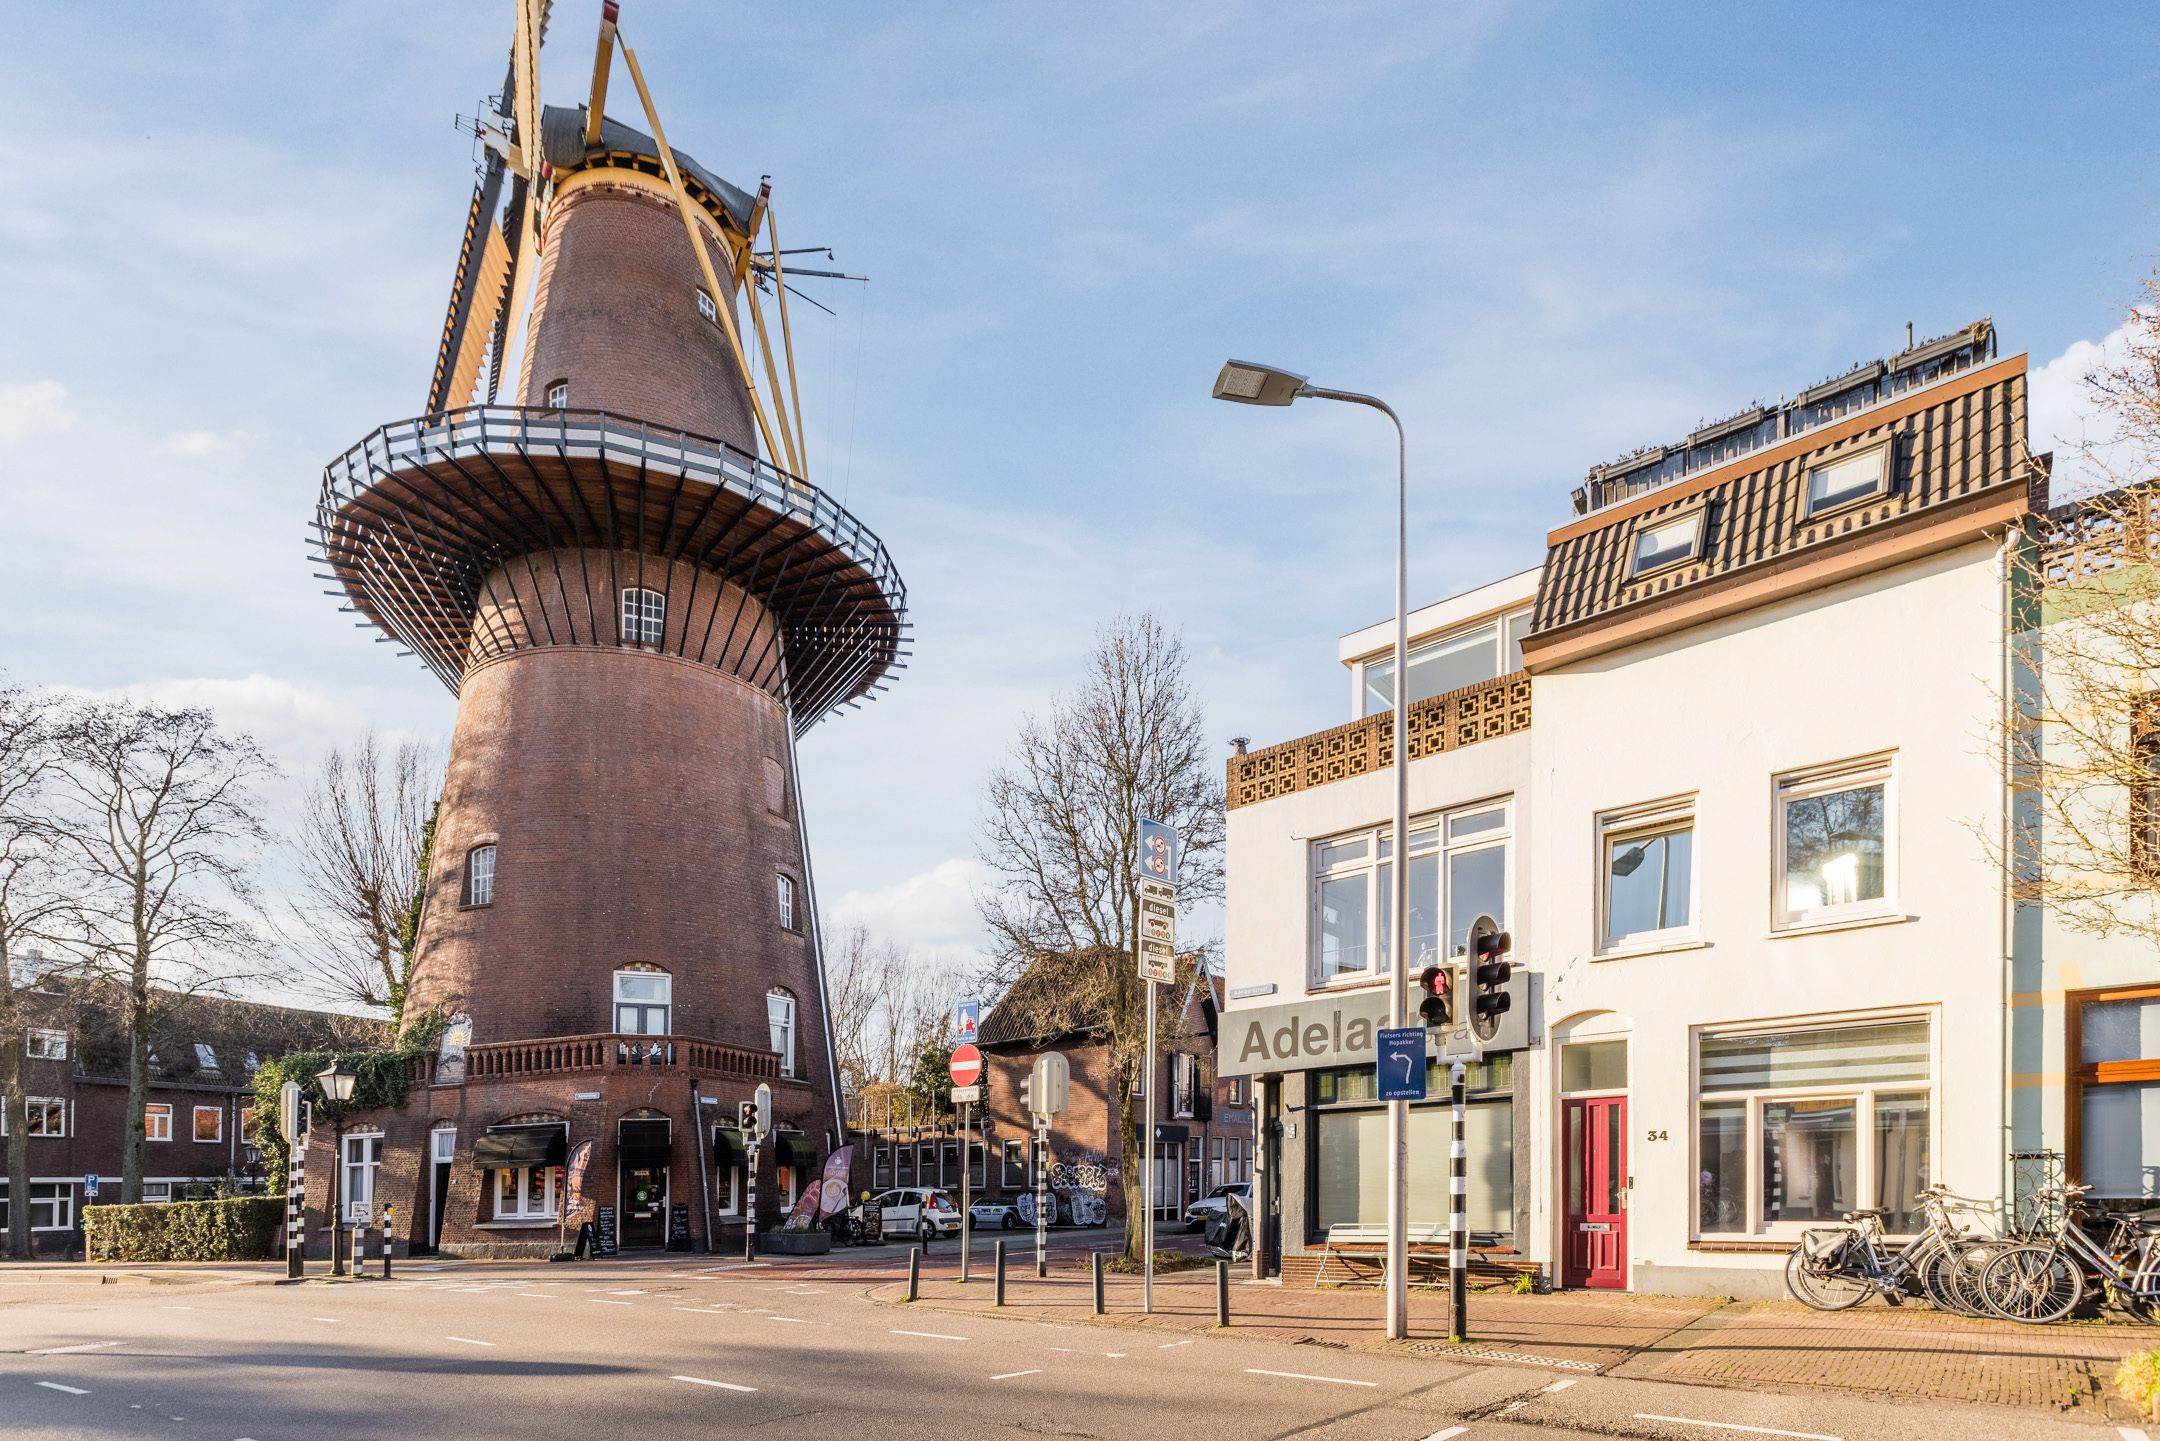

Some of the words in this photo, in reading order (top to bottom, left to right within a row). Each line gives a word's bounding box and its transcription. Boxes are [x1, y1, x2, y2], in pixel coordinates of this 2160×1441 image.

[1149, 903, 1169, 916] diesel
[1148, 943, 1168, 955] diesel
[1647, 1130, 1669, 1142] 34
